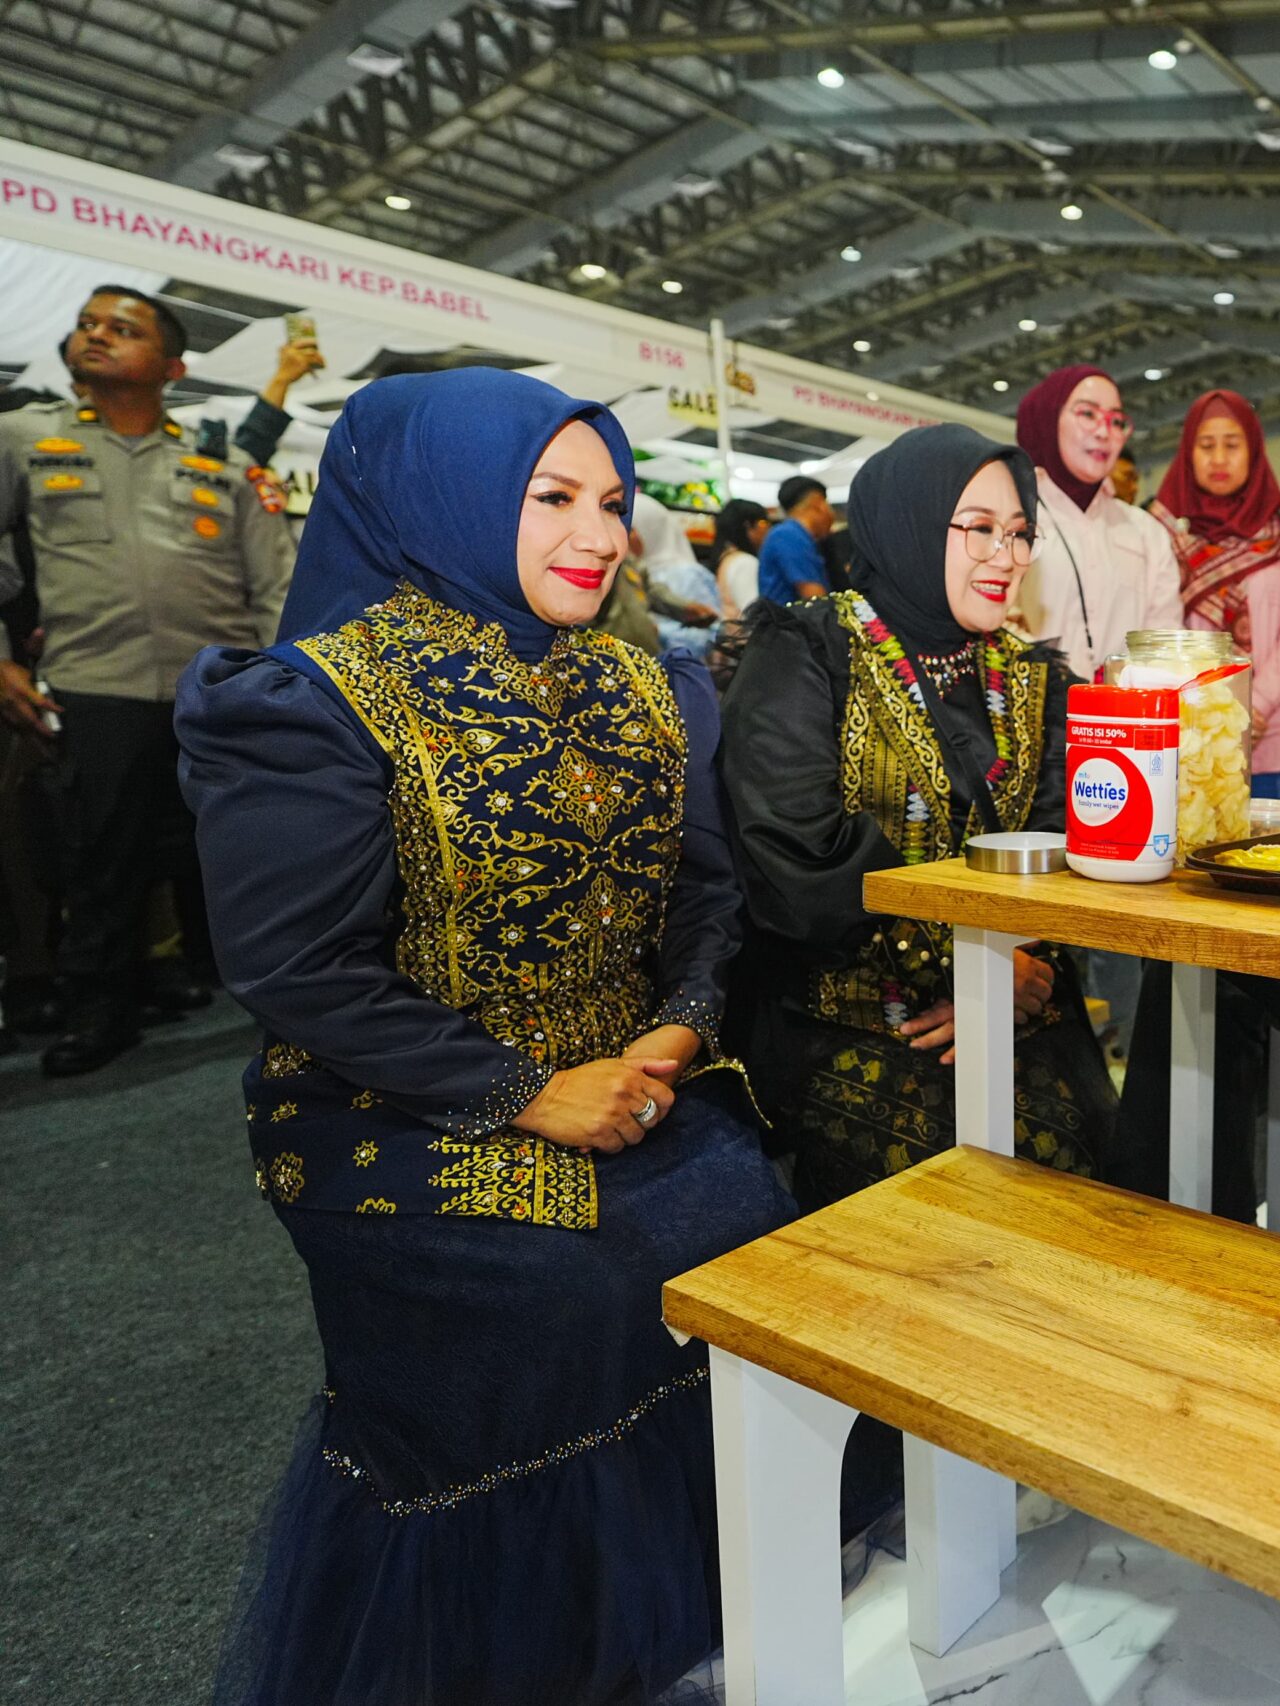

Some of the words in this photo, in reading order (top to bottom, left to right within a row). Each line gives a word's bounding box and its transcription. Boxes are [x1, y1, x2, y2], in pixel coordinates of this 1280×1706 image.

[2, 178, 57, 214] PD
[73, 196, 329, 281] BHAYANGKARI
[668, 386, 717, 415] SALE
[1071, 726, 1094, 736] GRATIS
[1094, 728, 1104, 737] ISI
[1105, 729, 1127, 738] 50%
[1075, 781, 1126, 801] Wetties
